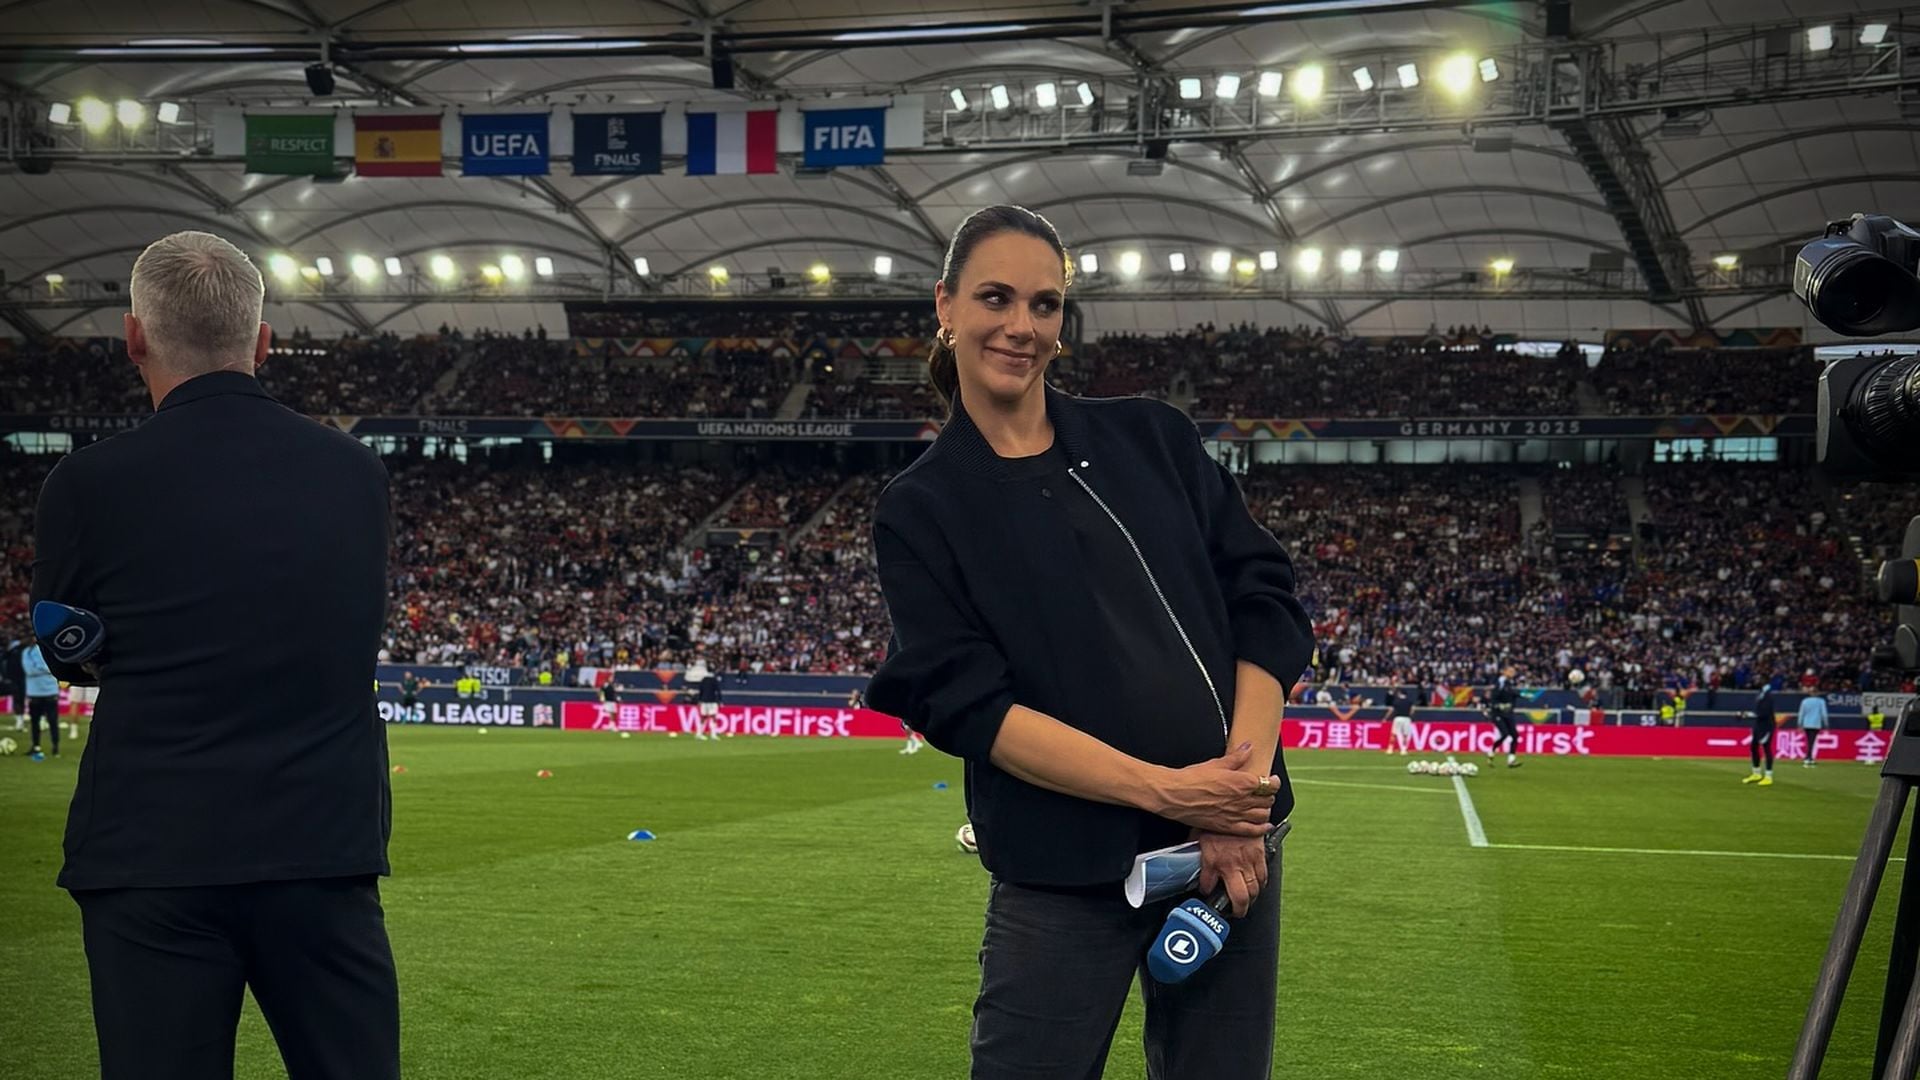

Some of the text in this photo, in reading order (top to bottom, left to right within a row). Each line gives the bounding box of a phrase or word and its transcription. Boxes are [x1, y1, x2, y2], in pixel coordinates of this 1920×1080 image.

[271, 138, 327, 151] RESPECT
[814, 125, 875, 150] FIFA
[471, 135, 540, 157] UEFA
[594, 153, 641, 166] FINALS
[50, 417, 140, 428] GERMANY
[419, 420, 468, 432] FINALS
[697, 423, 852, 436] UEFA NATIONS LEAGUE
[1401, 421, 1580, 435] GERMANY 2025
[432, 702, 524, 724] LEAGUE
[678, 706, 853, 736] WorldFirst
[1298, 721, 1382, 749] 万里汇
